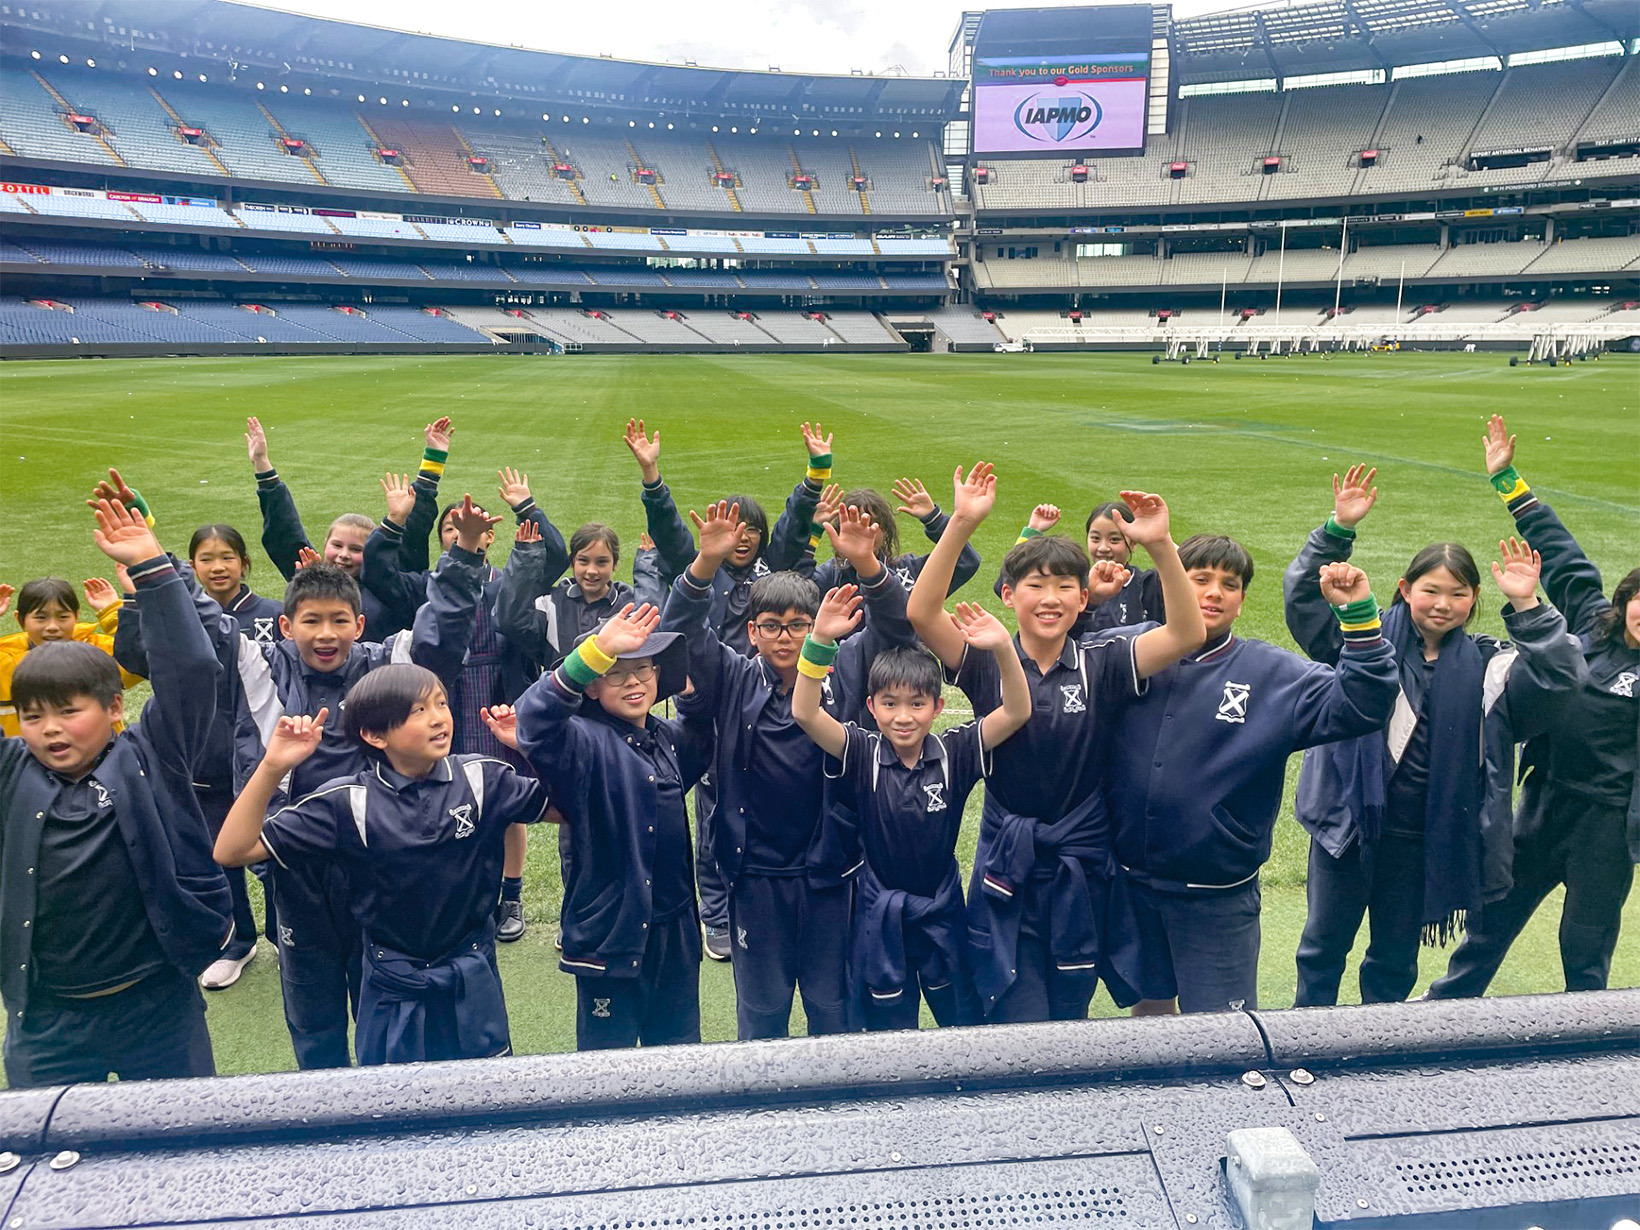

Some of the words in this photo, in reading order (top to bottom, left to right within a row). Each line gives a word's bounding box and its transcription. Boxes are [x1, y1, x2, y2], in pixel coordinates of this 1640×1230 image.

[989, 68, 1016, 76] Thank
[1019, 68, 1036, 77] you
[1039, 66, 1048, 75] to
[1051, 67, 1066, 75] our
[1068, 65, 1088, 75] Gold
[1091, 65, 1133, 75] Sponsors
[1025, 106, 1091, 124] IAPMO
[1491, 148, 1523, 156] ANTISOCIAL
[1523, 145, 1554, 153] BEHAVIOUR
[0, 184, 46, 195] FOXTEL
[64, 190, 95, 198] BRICKWORKS
[455, 218, 484, 227] CROWN
